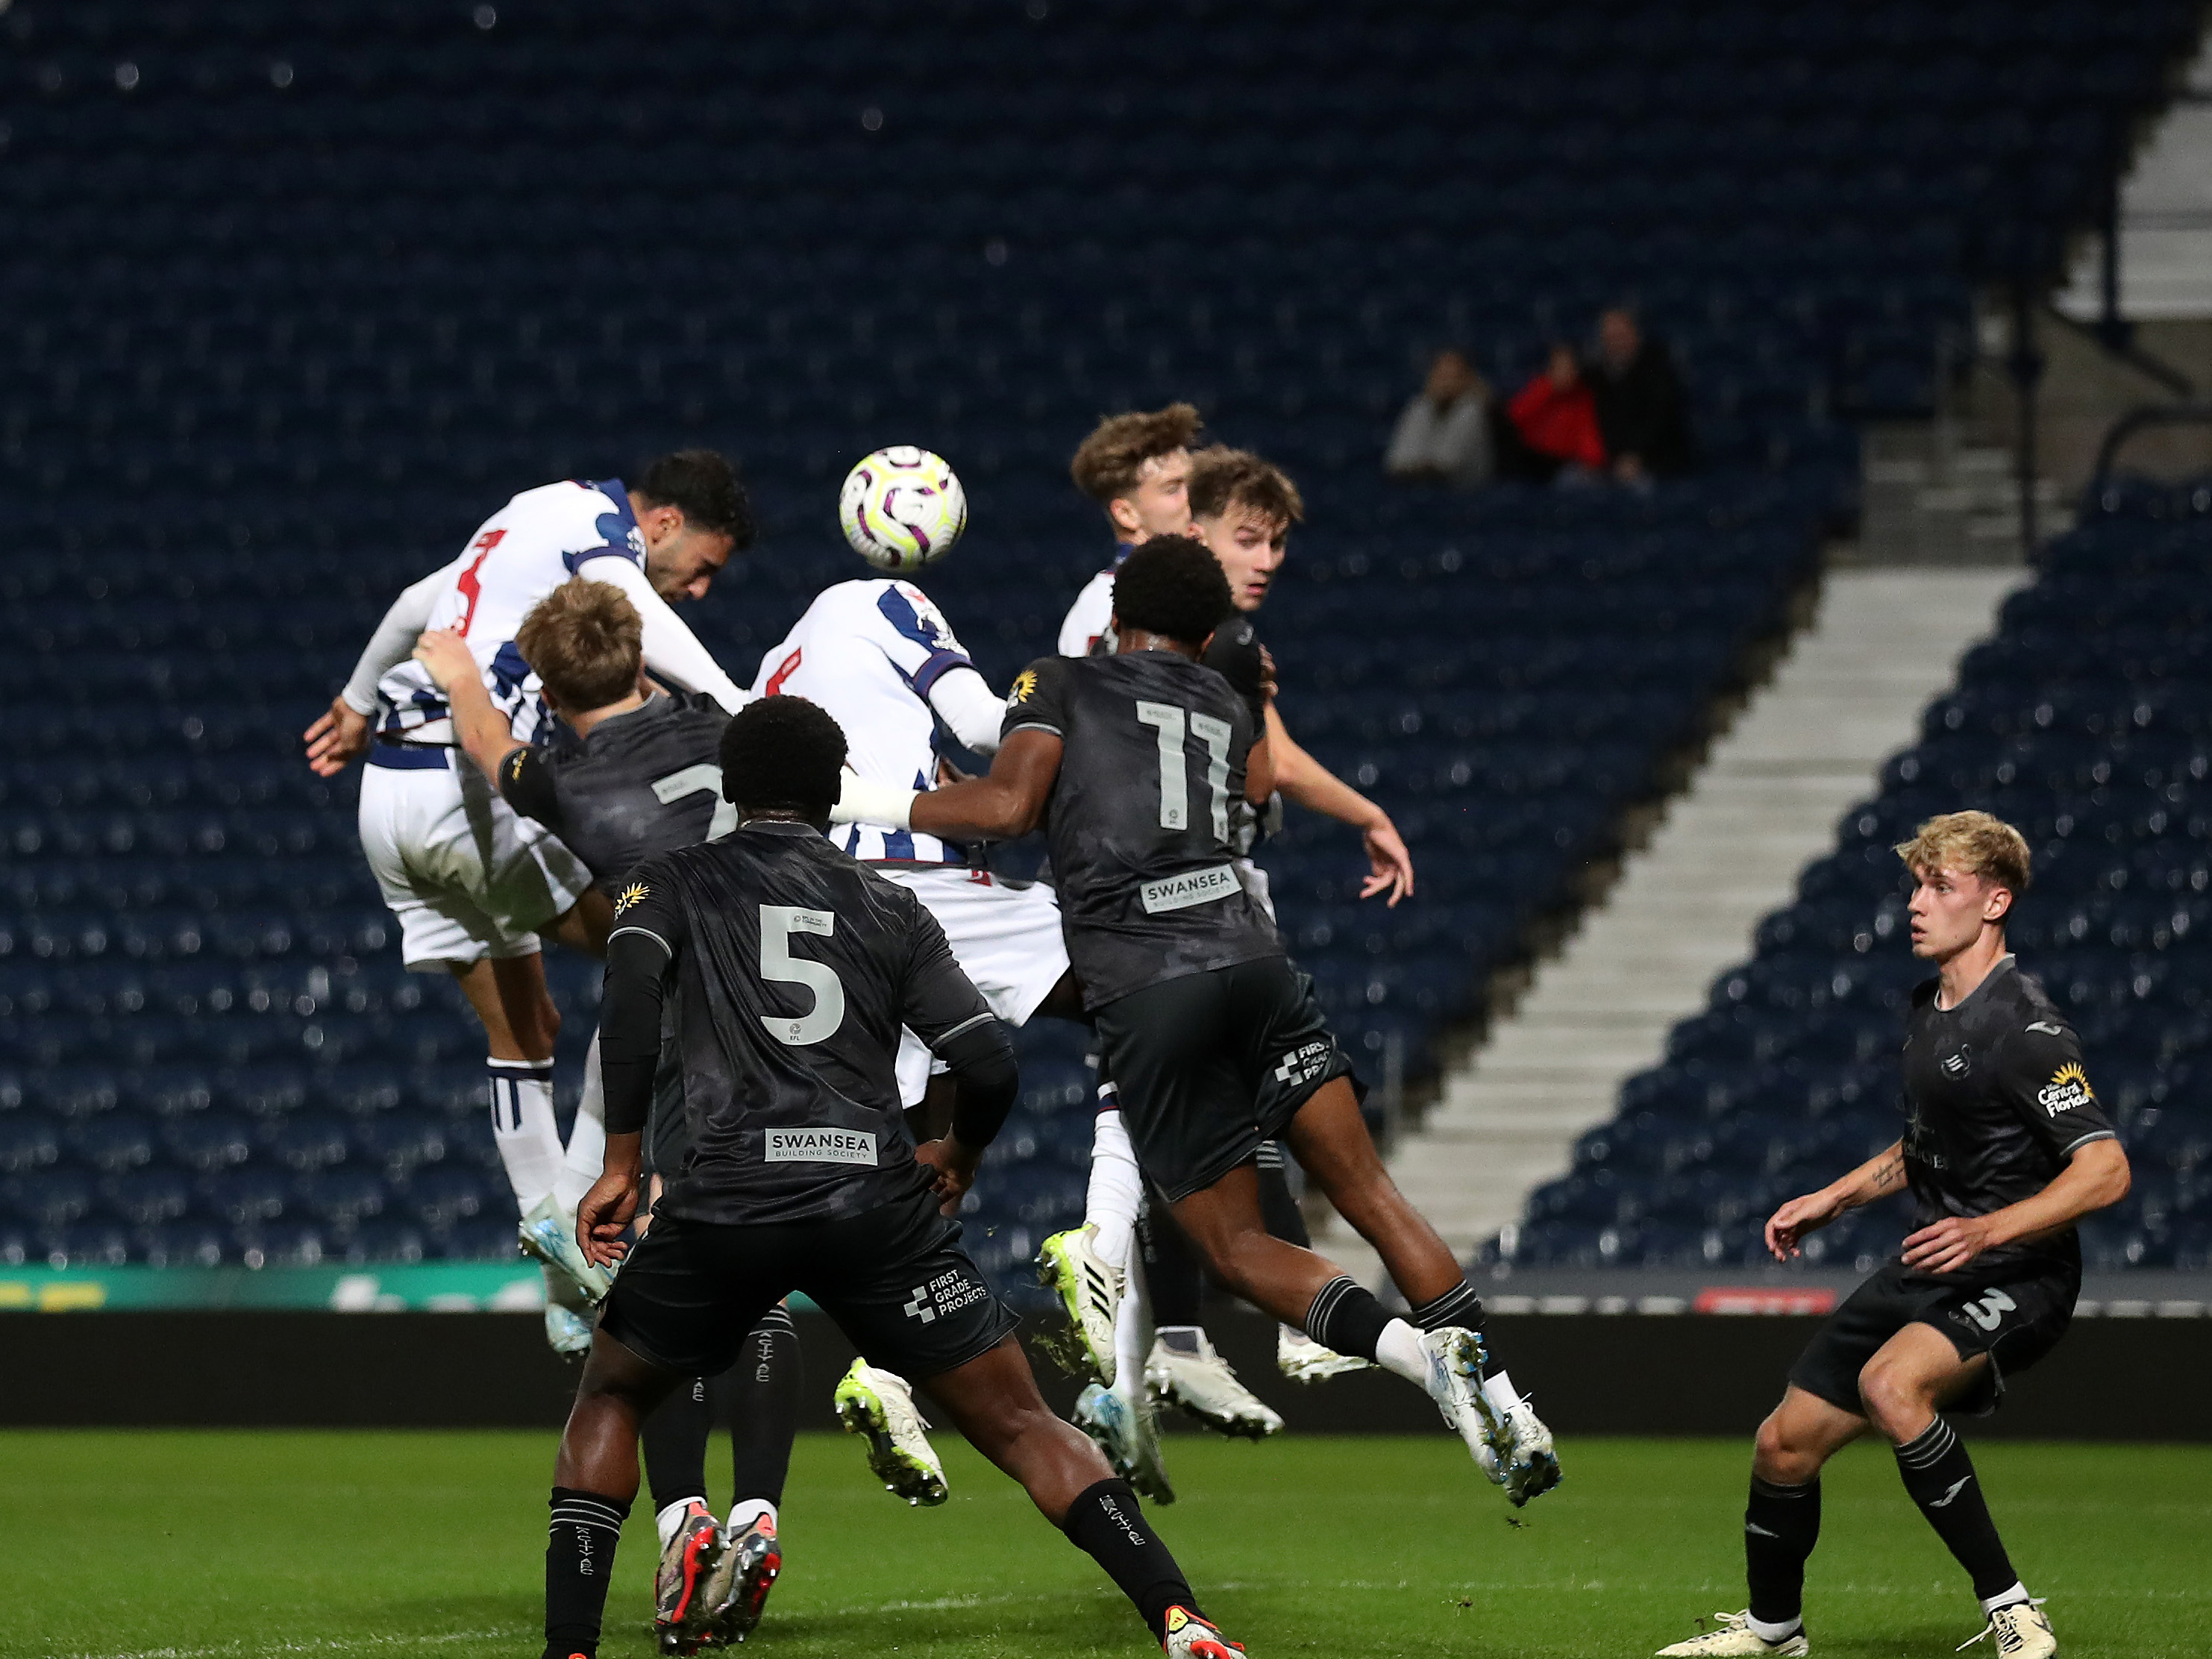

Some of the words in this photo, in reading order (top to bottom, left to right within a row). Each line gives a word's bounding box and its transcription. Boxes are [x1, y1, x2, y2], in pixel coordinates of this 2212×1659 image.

[1135, 700, 1232, 844] 11
[1148, 872, 1230, 900] SWANSEA
[759, 903, 845, 1046] 5
[772, 1134, 871, 1152] SWANSEA
[827, 1149, 868, 1158] SOCIETY
[929, 1269, 959, 1292] FIRST
[935, 1279, 971, 1303] GRADE
[938, 1285, 987, 1317] PROJECTS
[1961, 1286, 2018, 1332] 3
